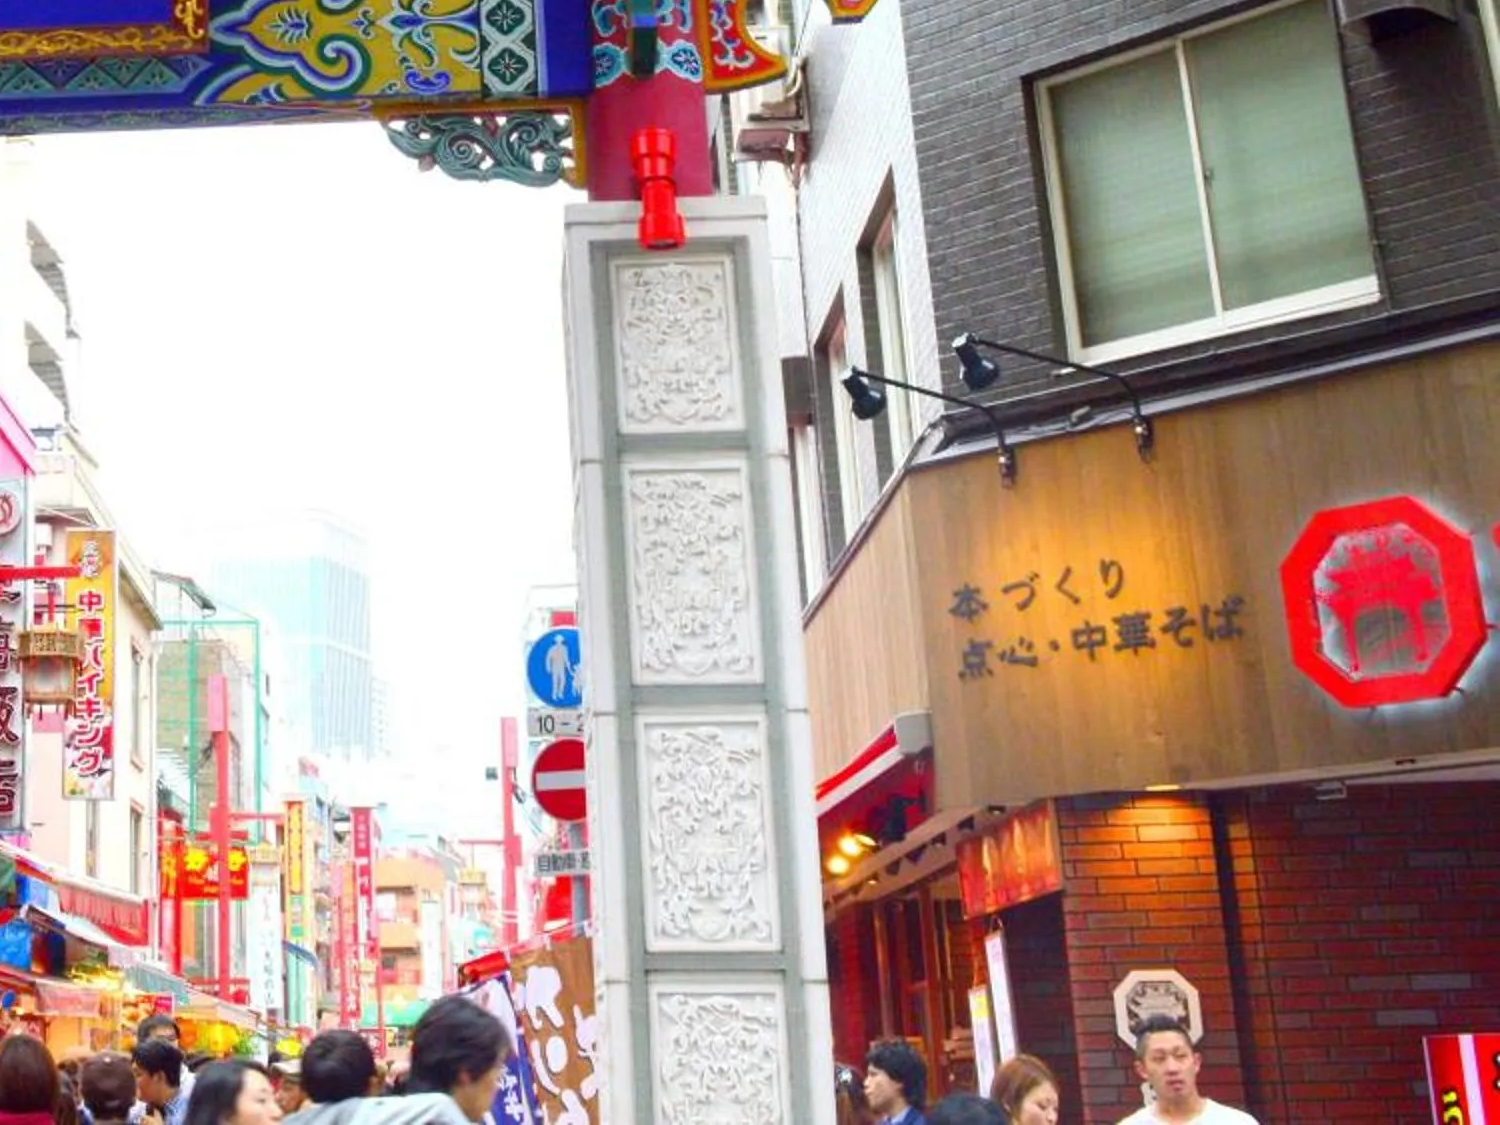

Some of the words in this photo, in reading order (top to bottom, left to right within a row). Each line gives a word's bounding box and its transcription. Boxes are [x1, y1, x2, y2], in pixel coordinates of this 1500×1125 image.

[948, 559, 1124, 622] 本づくり
[958, 595, 1245, 680] 点心・中華そば
